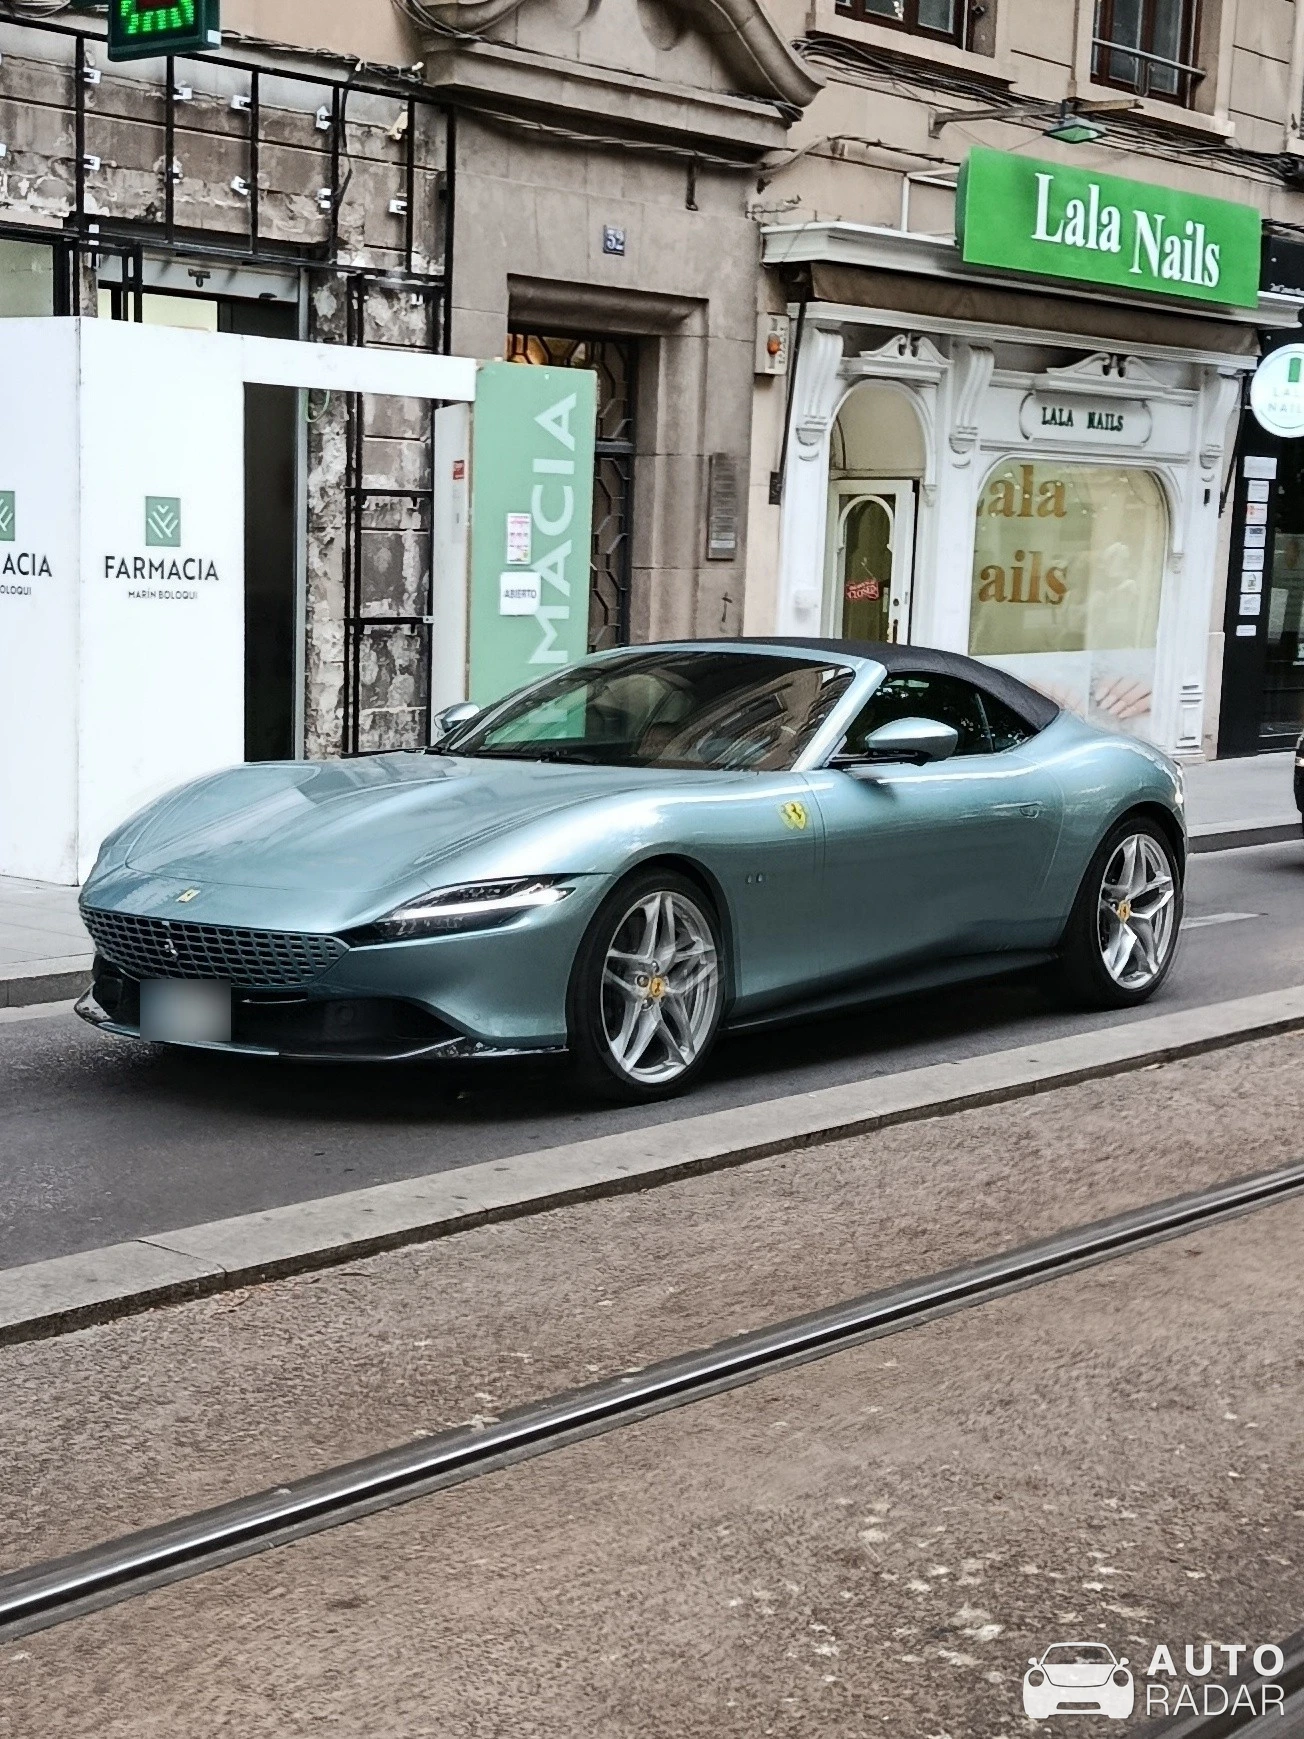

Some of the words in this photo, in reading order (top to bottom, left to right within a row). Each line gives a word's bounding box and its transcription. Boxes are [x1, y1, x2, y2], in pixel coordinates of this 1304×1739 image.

[1030, 172, 1121, 253] Lala
[1129, 209, 1220, 288] Nails
[1041, 406, 1074, 427] LALA
[1087, 411, 1124, 432] NAILS
[977, 464, 1067, 518] ala
[529, 392, 577, 665] MACIA
[104, 555, 220, 581] FARMACIA
[158, 590, 198, 600] BOLOQUI
[974, 549, 1069, 605] ails
